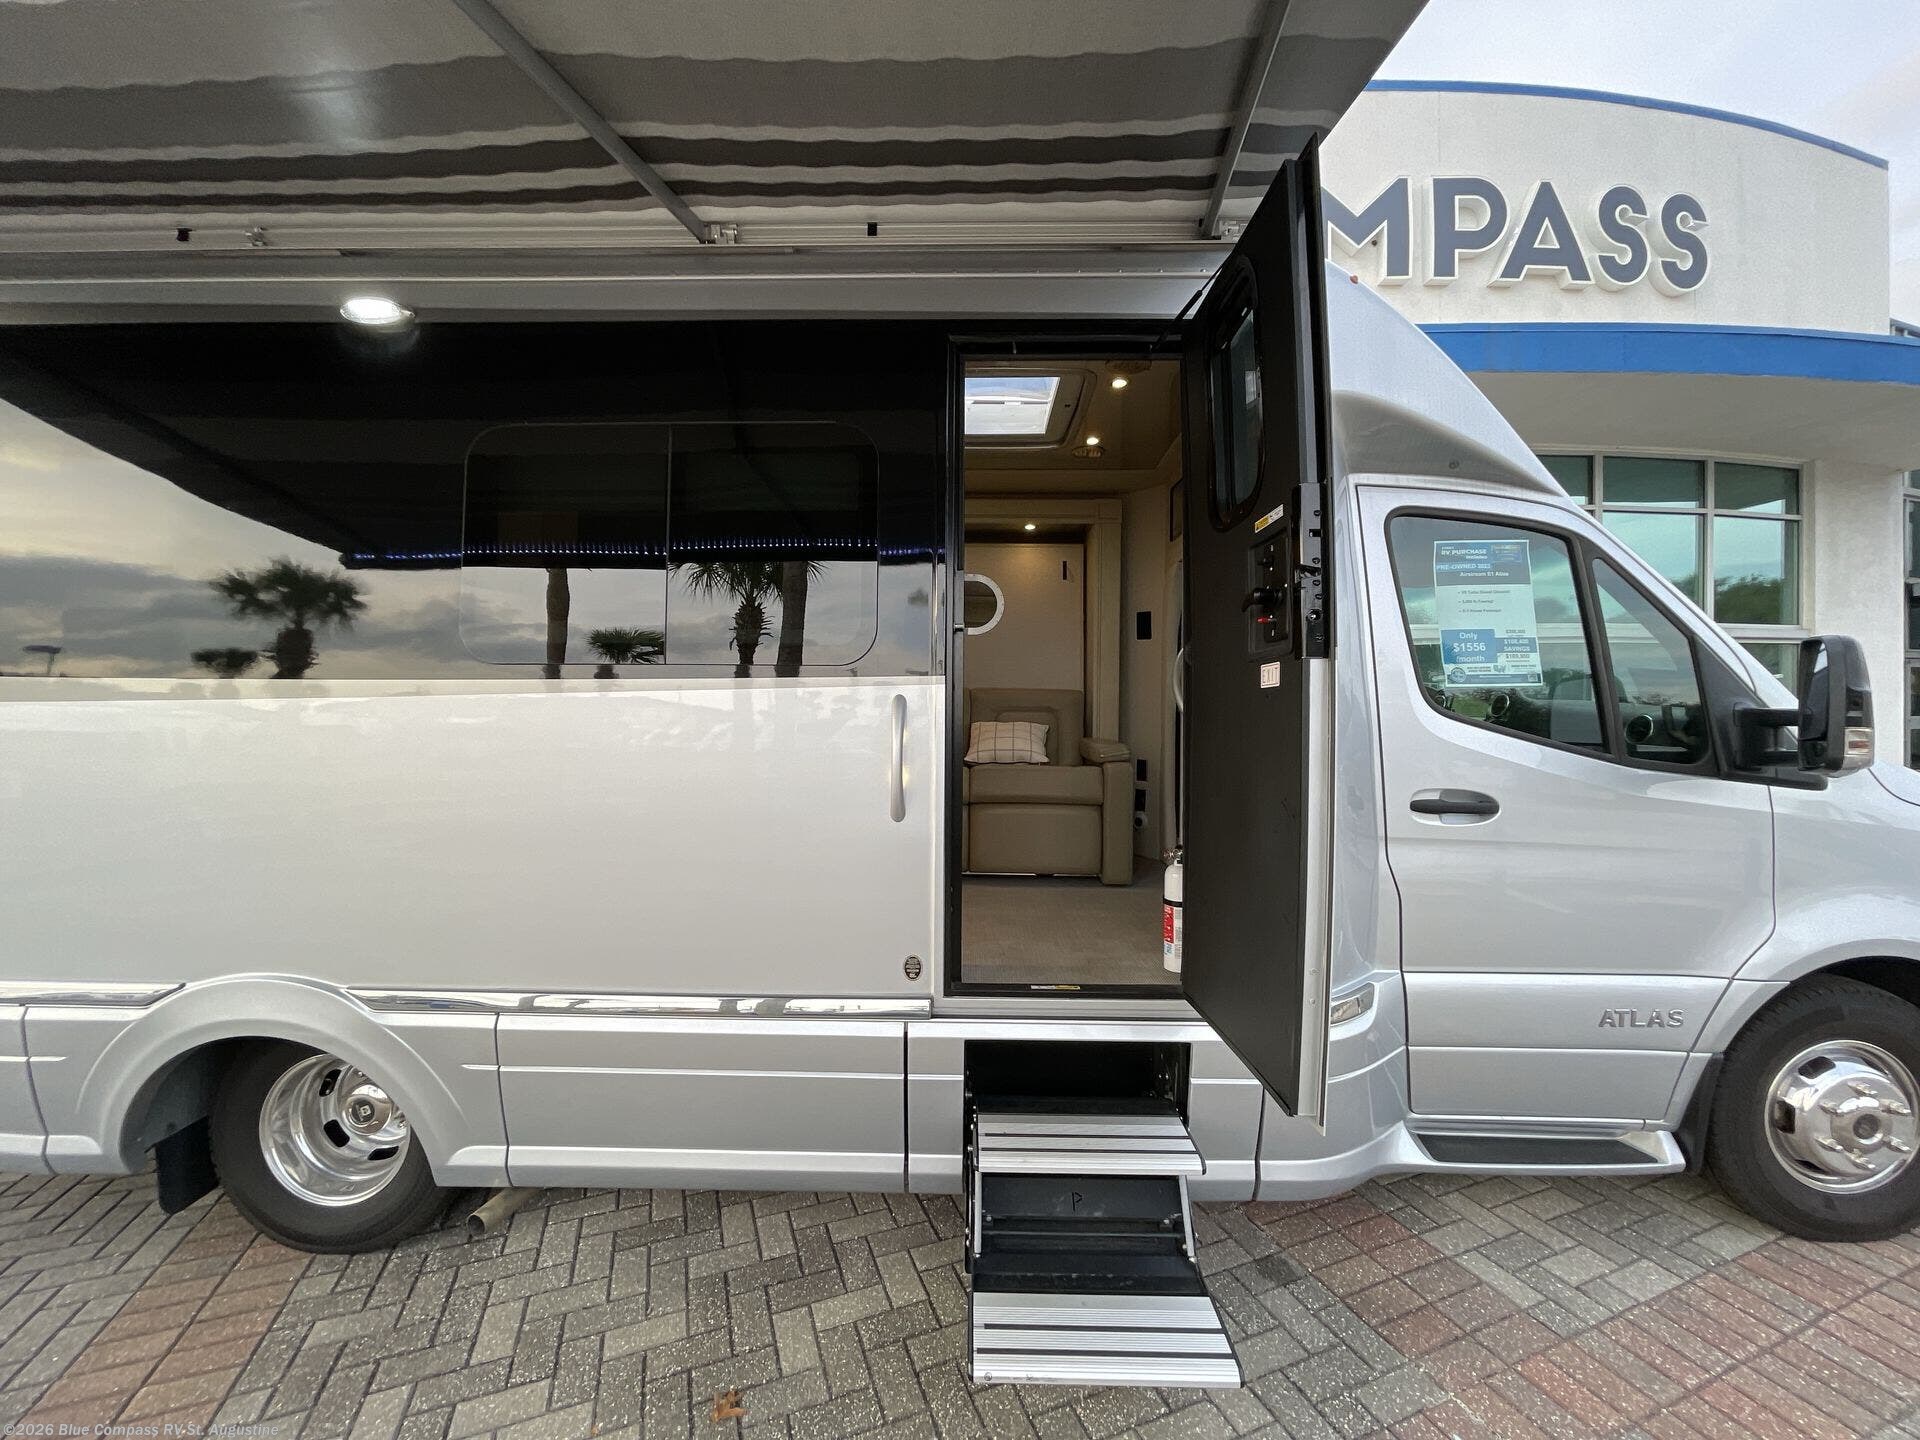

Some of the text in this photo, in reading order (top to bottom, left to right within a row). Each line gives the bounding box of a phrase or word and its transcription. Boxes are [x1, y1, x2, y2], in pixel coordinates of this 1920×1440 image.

[1459, 632, 1478, 640] Only
[1453, 642, 1486, 652] $1556
[1598, 1008, 1685, 1028] ATLAS
